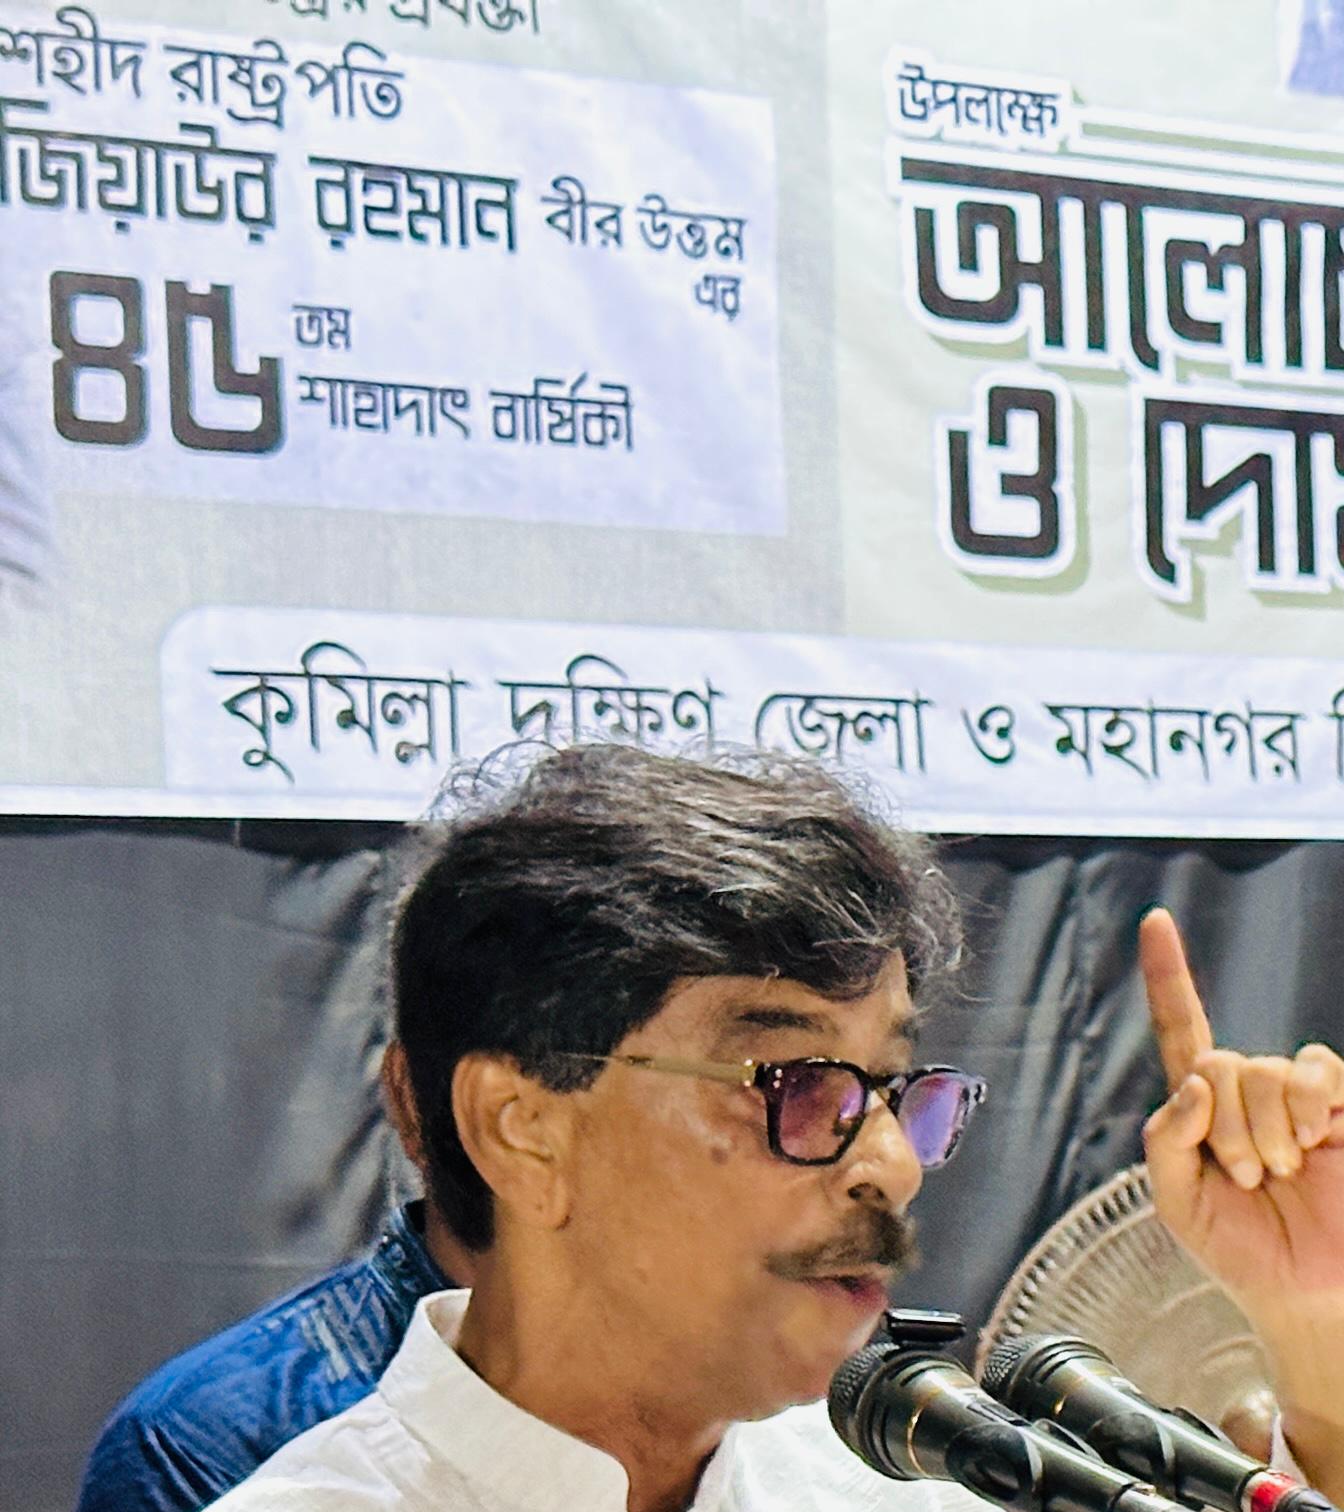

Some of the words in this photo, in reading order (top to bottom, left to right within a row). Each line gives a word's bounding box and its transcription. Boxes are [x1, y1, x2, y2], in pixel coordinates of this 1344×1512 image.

[0, 6, 147, 98] শহীদ
[163, 39, 404, 129] রাষ্ট্রপতি
[0, 96, 277, 244] জিয়াউর
[308, 154, 518, 254] রহমান
[541, 176, 624, 248] বীর
[637, 194, 748, 261] উত্তম
[50, 269, 284, 456] ৪৫
[293, 304, 352, 351] তম
[694, 274, 742, 322] এর
[298, 375, 472, 441] শাহাদাৎ
[490, 372, 637, 453] বার্ষিকী
[948, 385, 1060, 561] ও
[209, 641, 471, 784] কুমিল্লা
[494, 654, 726, 755] দক্ষিণ
[754, 688, 937, 773] জেলা
[963, 703, 1017, 767] ও
[1044, 697, 1305, 785] মহানগর
